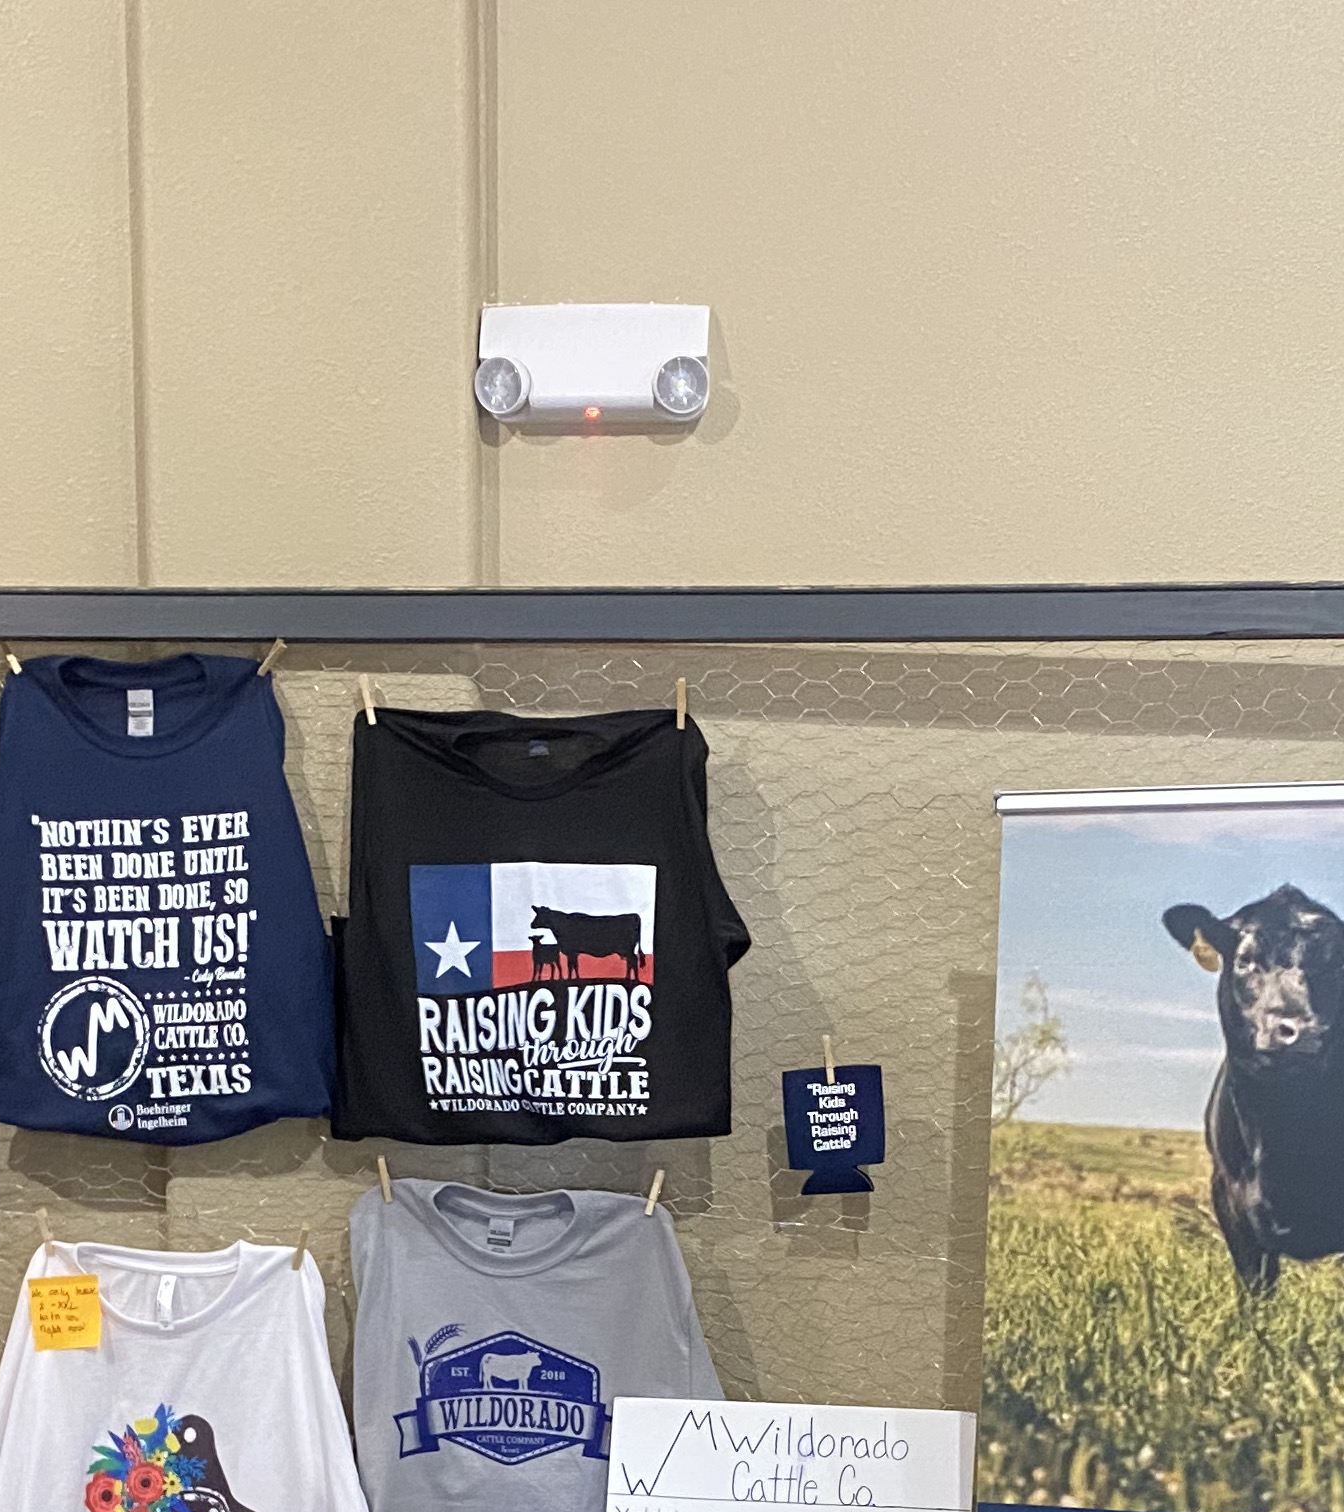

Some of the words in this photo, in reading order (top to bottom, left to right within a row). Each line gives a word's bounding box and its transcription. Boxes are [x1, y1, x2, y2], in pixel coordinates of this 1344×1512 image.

[181, 811, 250, 843] EVER
[40, 853, 103, 881] BEEN
[111, 850, 176, 879] DONE
[183, 845, 249, 875] UNTIL
[42, 887, 87, 914] IT'S
[94, 885, 150, 913] BEEN
[157, 881, 216, 911] DONE,
[223, 878, 249, 905] SO
[42, 916, 180, 971] WATCH
[153, 999, 247, 1024] WILDORADO
[417, 988, 557, 1054] RAISING
[566, 984, 652, 1042] KIDS
[154, 1025, 219, 1050] CATTLE
[223, 1022, 250, 1046] CO.
[519, 1027, 639, 1075] through
[145, 1063, 252, 1099] TEXAS
[422, 1056, 521, 1096] RAISING
[523, 1068, 650, 1099] CATTLE
[136, 1103, 192, 1116] Boehringer
[437, 1099, 520, 1112] WILDORADO
[567, 1102, 637, 1116] COMPANY
[807, 1108, 859, 1124] Through
[818, 1096, 846, 1109] Kids
[137, 1116, 188, 1131] Ingelheim
[811, 1123, 857, 1137] Raising
[451, 1367, 472, 1377] EST.
[439, 1397, 584, 1435] WILDORADO
[476, 1435, 504, 1444] CATTLE
[506, 1436, 546, 1445] COMPANY
[721, 1416, 910, 1461] Wildorado
[731, 1461, 818, 1505] Cattle
[838, 1464, 876, 1507] Co.
